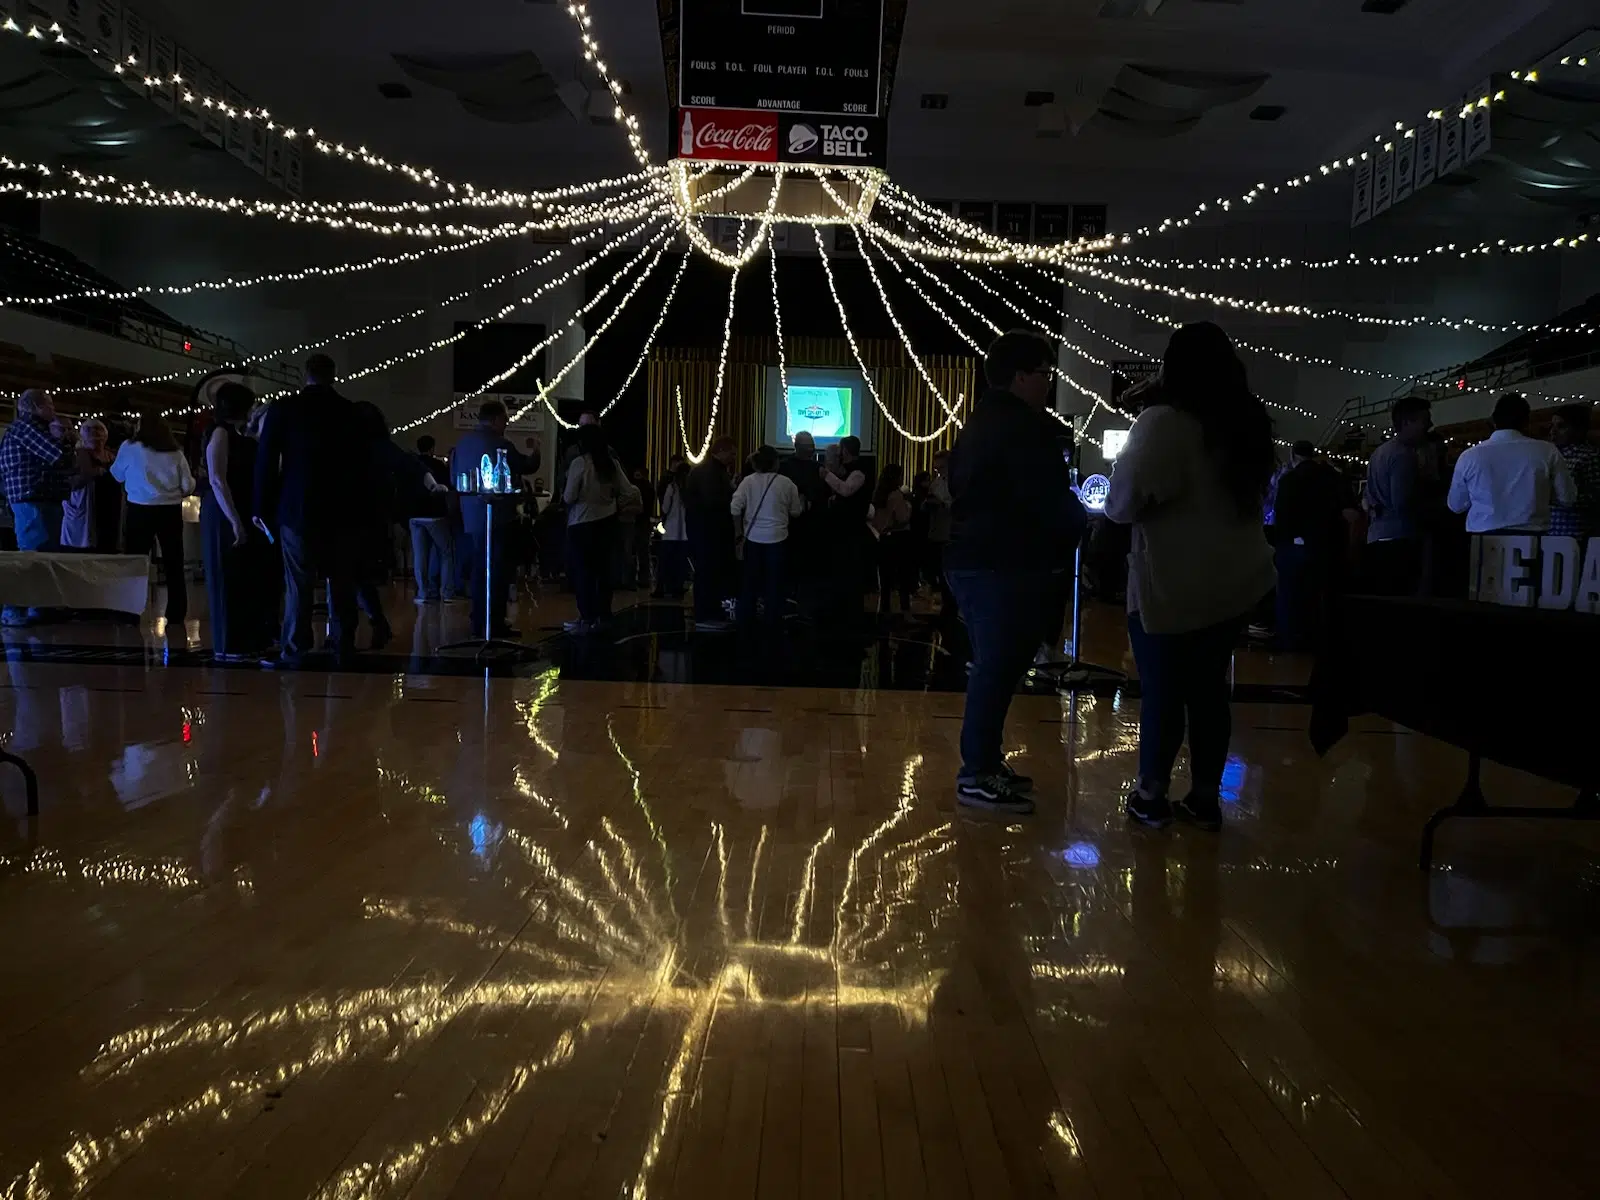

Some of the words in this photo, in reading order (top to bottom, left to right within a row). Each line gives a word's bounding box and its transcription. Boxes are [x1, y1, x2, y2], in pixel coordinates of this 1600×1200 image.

[767, 24, 796, 36] PERIOD
[690, 60, 717, 71] FOULS
[753, 63, 774, 74] FOUL
[777, 65, 807, 76] PLAYER
[843, 68, 869, 78] FOULS
[691, 95, 716, 106] SCORE
[756, 98, 801, 110] ADVANTAGE
[843, 102, 868, 113] SCORE
[695, 121, 777, 152] Coca-Cola
[819, 124, 869, 142] TACO
